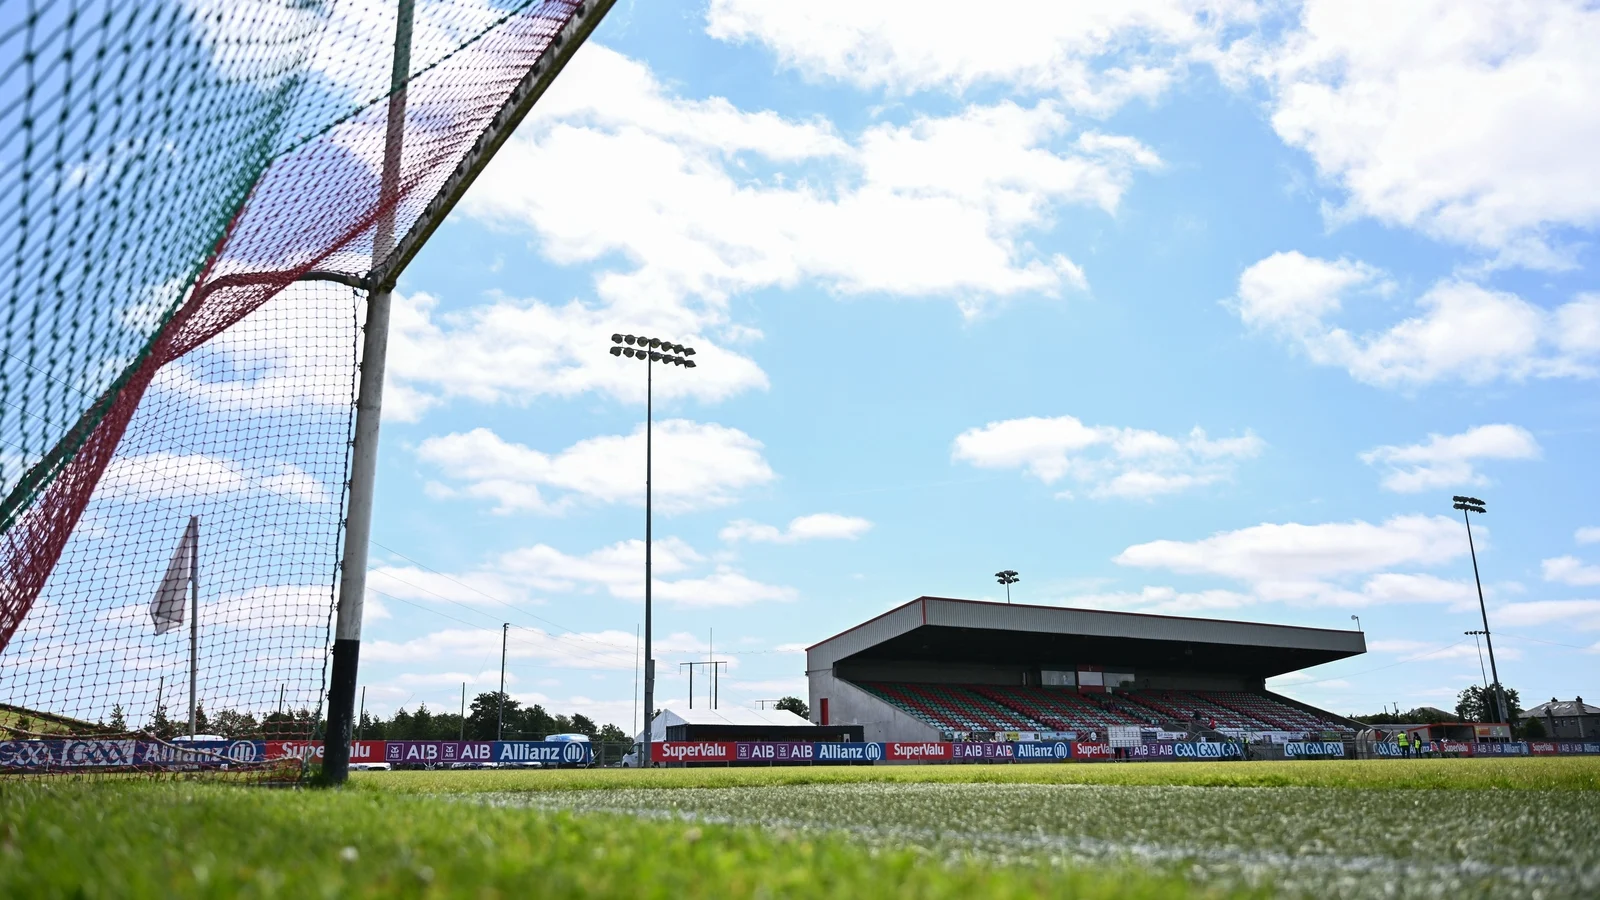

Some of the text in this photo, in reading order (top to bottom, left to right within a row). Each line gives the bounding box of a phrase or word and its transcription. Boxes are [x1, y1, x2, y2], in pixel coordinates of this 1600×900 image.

[142, 743, 224, 762] Allianz
[281, 742, 370, 763] Supelu
[406, 745, 437, 759] AIB
[460, 745, 491, 759] AIB
[500, 743, 559, 760] Allianz
[662, 743, 726, 760] SuperValu
[752, 745, 775, 758] AIB
[791, 745, 813, 758] AIB
[819, 744, 863, 758] Allianz
[894, 743, 944, 759] SuperValu
[964, 745, 983, 757] AIB
[1018, 744, 1053, 757] Allianz
[1134, 745, 1148, 756] AIB
[1159, 745, 1173, 755] AIB
[1175, 743, 1197, 757] GAA
[1200, 743, 1220, 757] GAA
